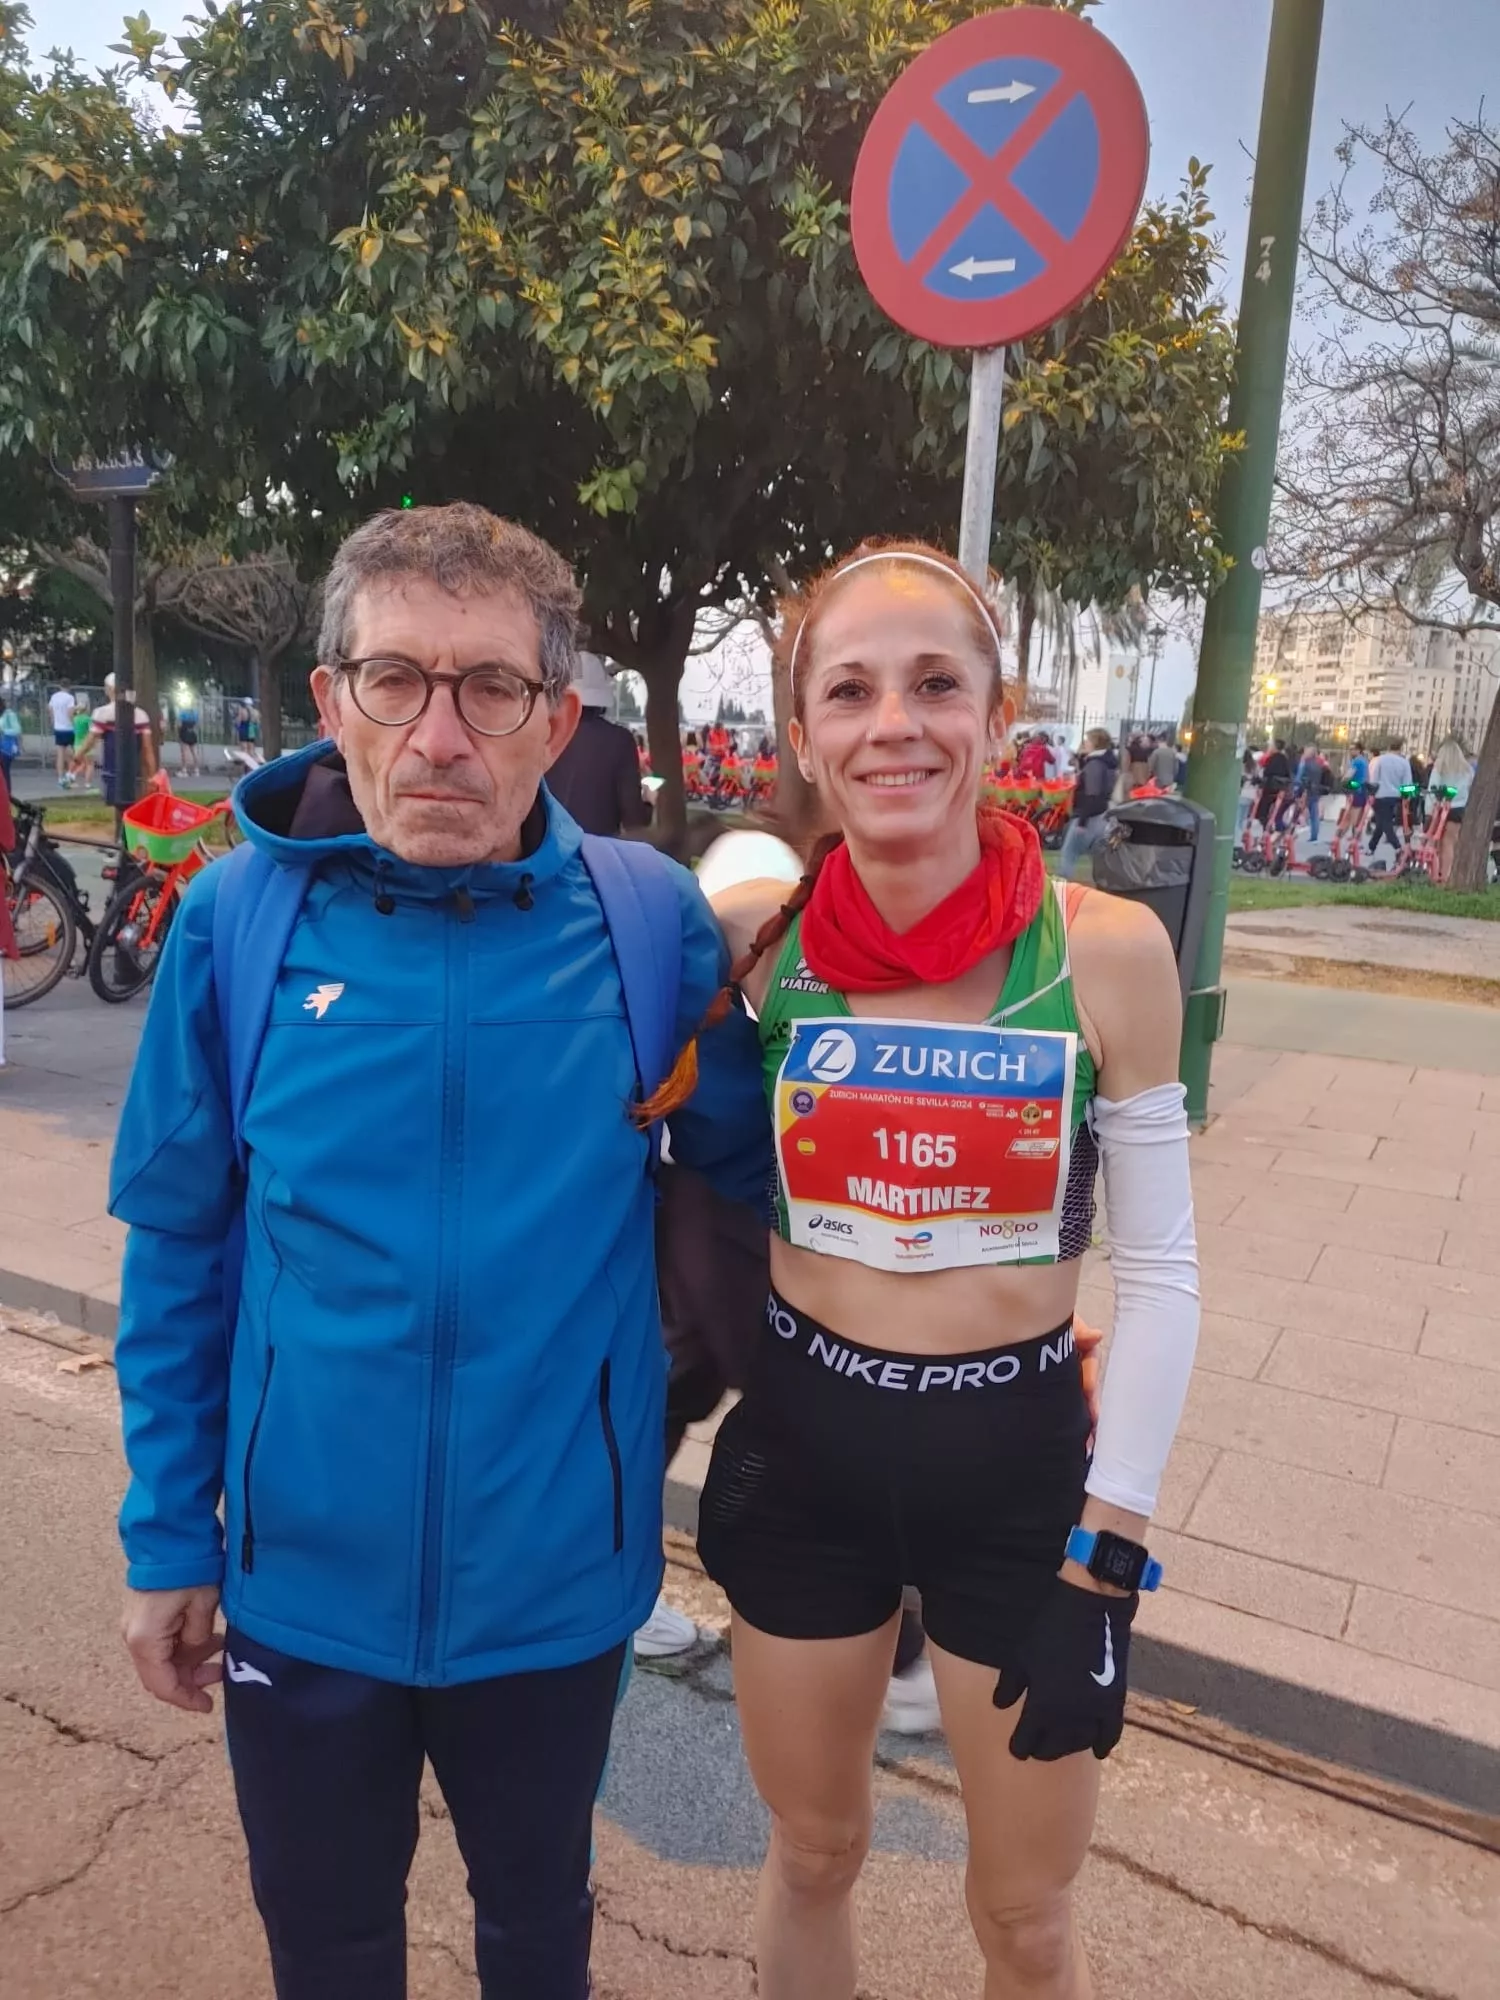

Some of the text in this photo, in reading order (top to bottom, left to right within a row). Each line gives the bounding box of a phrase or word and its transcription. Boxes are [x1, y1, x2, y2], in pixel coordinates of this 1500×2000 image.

[780, 977, 829, 994] VIATOR
[873, 1044, 1026, 1082] ZURICH
[830, 1090, 972, 1109] ZURICH MARATÓN DE SEVILLA 2024
[873, 1127, 957, 1167] 1165
[847, 1176, 991, 1215] MARTINEZ
[808, 1333, 917, 1390] NIKE
[918, 1355, 1021, 1392] PRO
